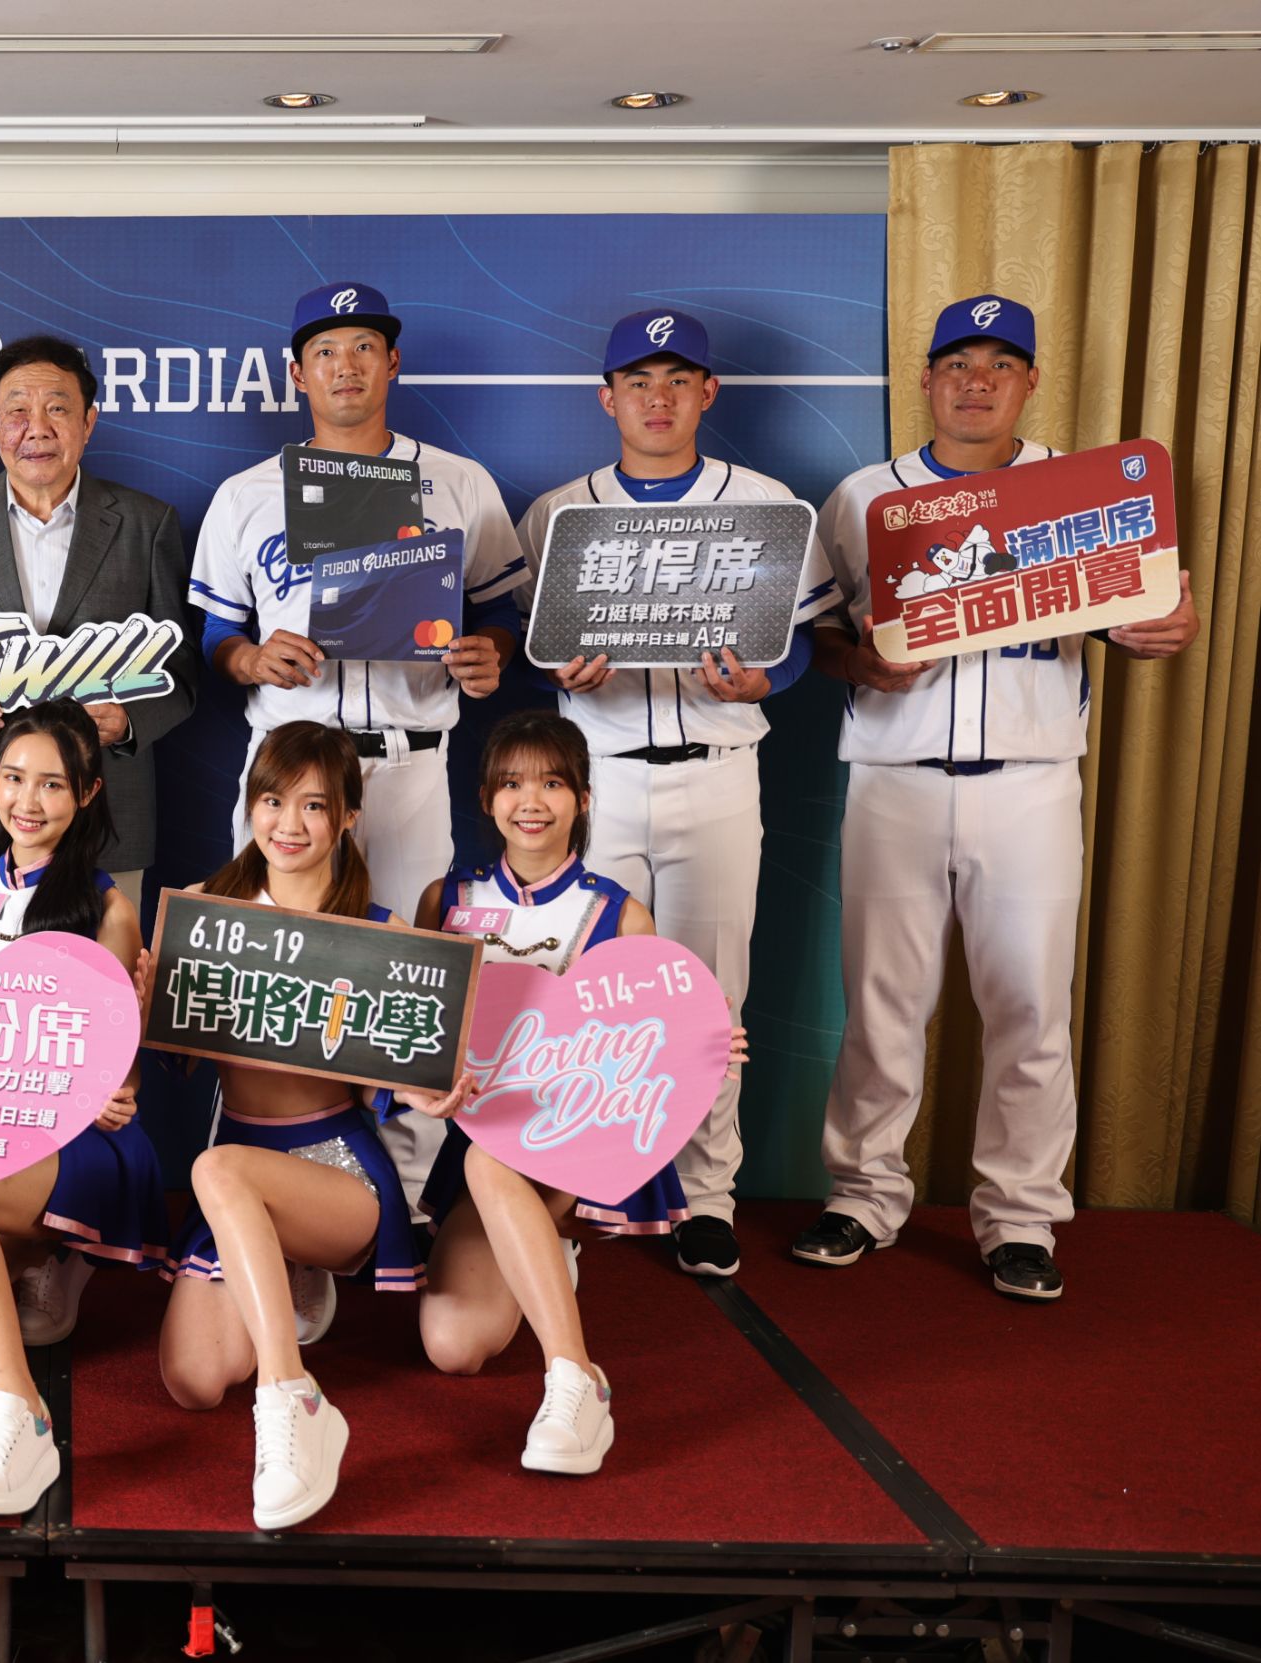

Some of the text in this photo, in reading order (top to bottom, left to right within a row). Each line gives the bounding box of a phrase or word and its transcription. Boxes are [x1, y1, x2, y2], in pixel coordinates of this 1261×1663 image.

[298, 457, 412, 482] FUBON GUARDIANS
[909, 491, 979, 525] 起家雞
[614, 518, 735, 533] GUARDIANS
[1004, 495, 1156, 568] 滿悍席
[302, 541, 336, 550] titanium
[322, 543, 447, 578] FUBON GUARDIANS
[576, 536, 767, 594] 鐵悍席
[587, 603, 736, 623] 力挺悍將不缺席
[900, 544, 1146, 651] 全面開賣
[579, 632, 690, 647] 週四悍將平日主場
[387, 960, 447, 988] XVIII
[167, 957, 445, 1064] 悍將中學
[465, 1011, 664, 1112] Loving
[521, 1070, 675, 1154] Day
